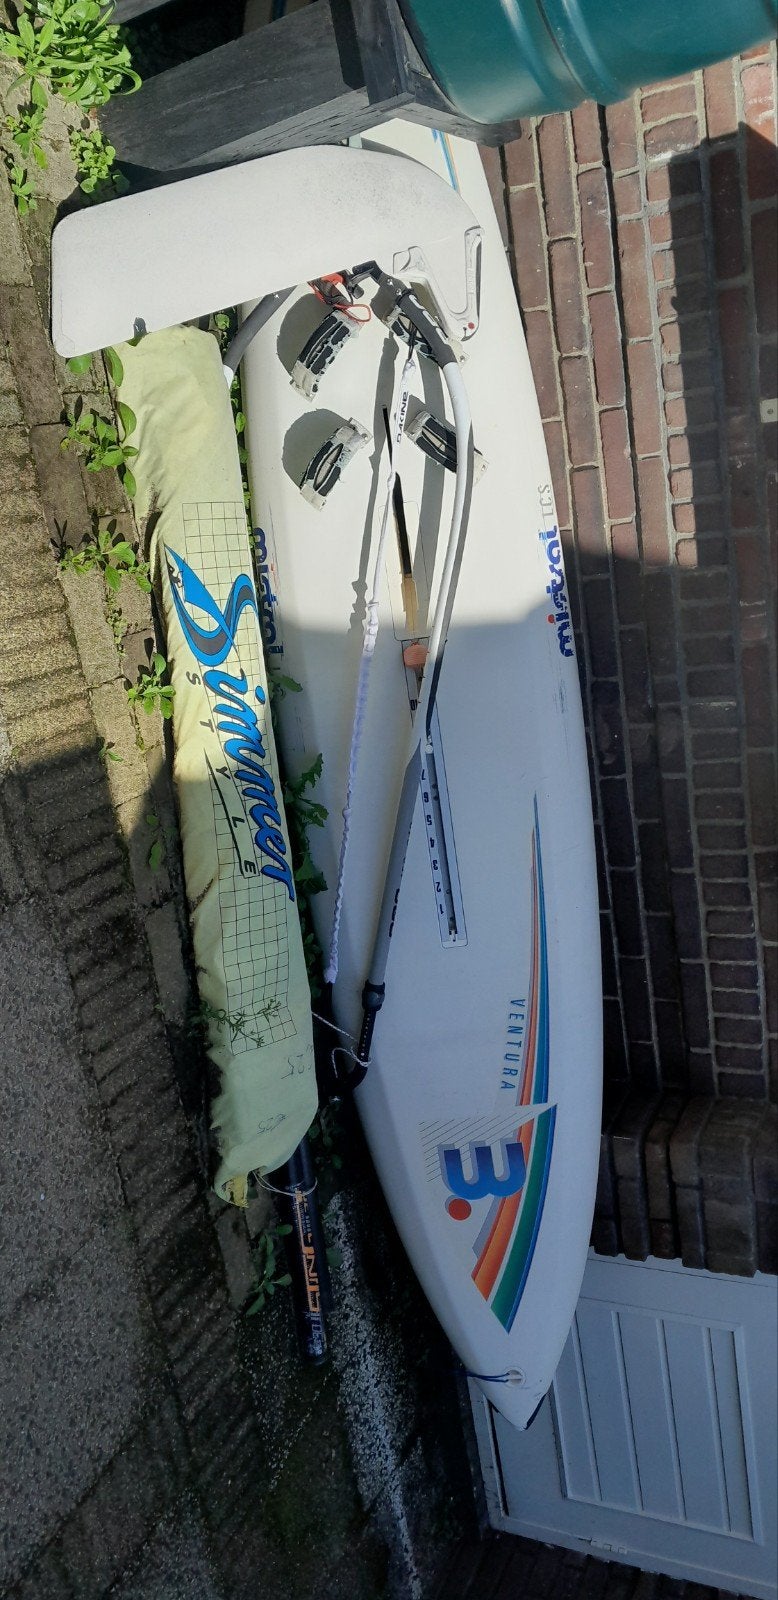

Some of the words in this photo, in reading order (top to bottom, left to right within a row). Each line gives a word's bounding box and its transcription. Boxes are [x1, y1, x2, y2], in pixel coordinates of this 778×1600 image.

[539, 525, 574, 658] mistral
[163, 542, 295, 902] Simmer
[500, 998, 527, 1090] VENTURA
